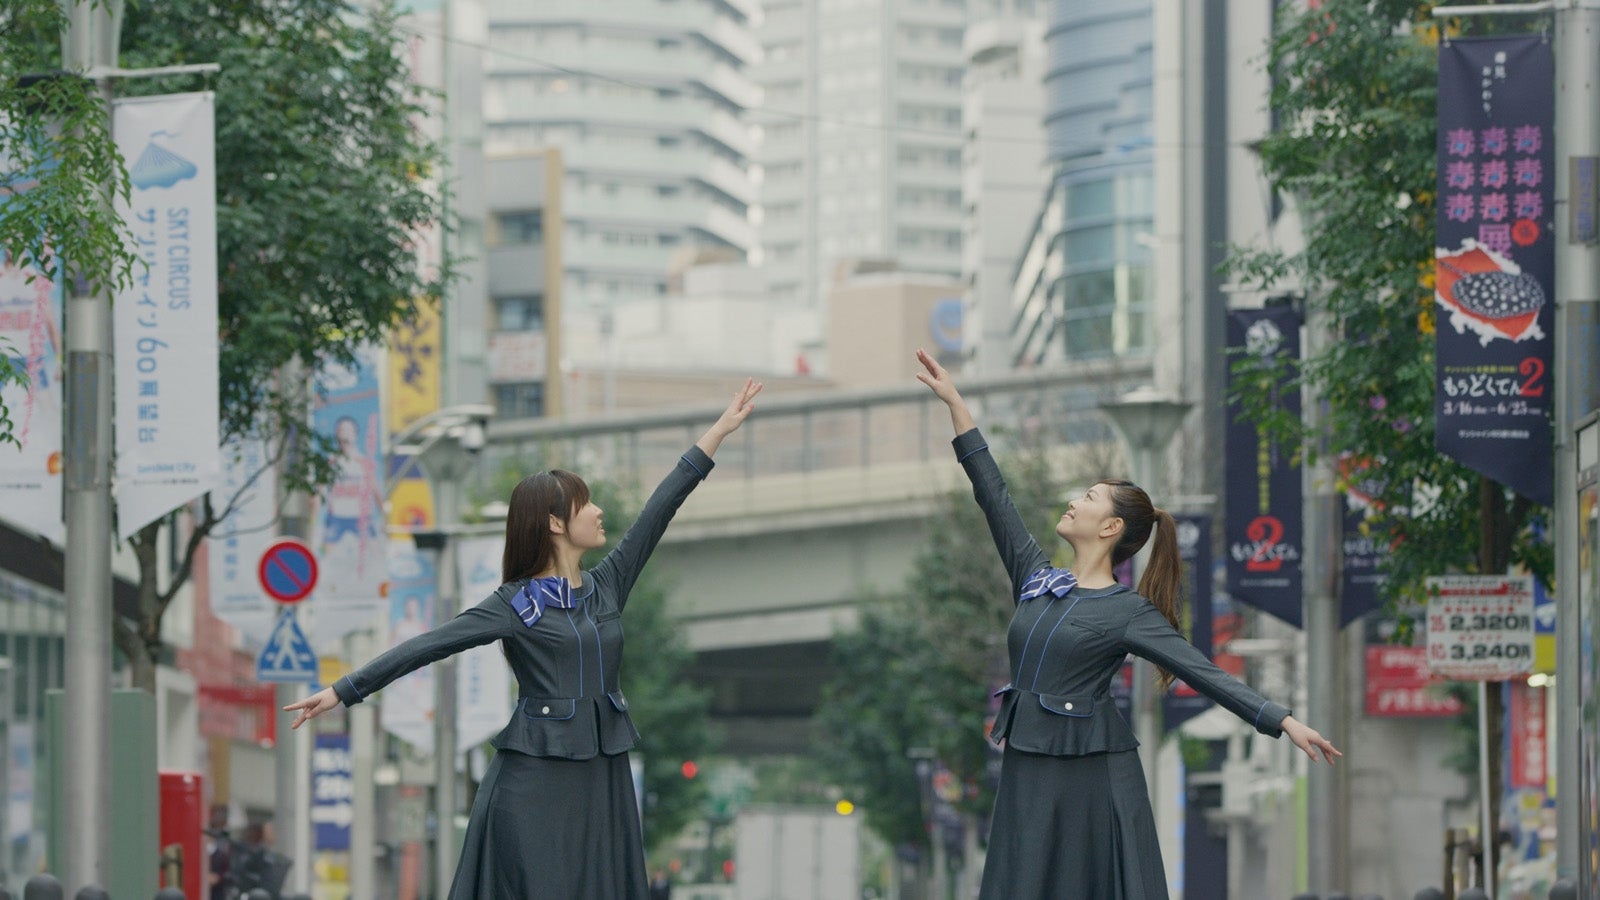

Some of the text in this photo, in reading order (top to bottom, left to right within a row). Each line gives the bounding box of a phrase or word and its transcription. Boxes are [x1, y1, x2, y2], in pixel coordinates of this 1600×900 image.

[167, 208, 191, 310] SKY CIRCUS
[1443, 356, 1545, 397] もうどくてん 2
[1246, 516, 1284, 571] 2
